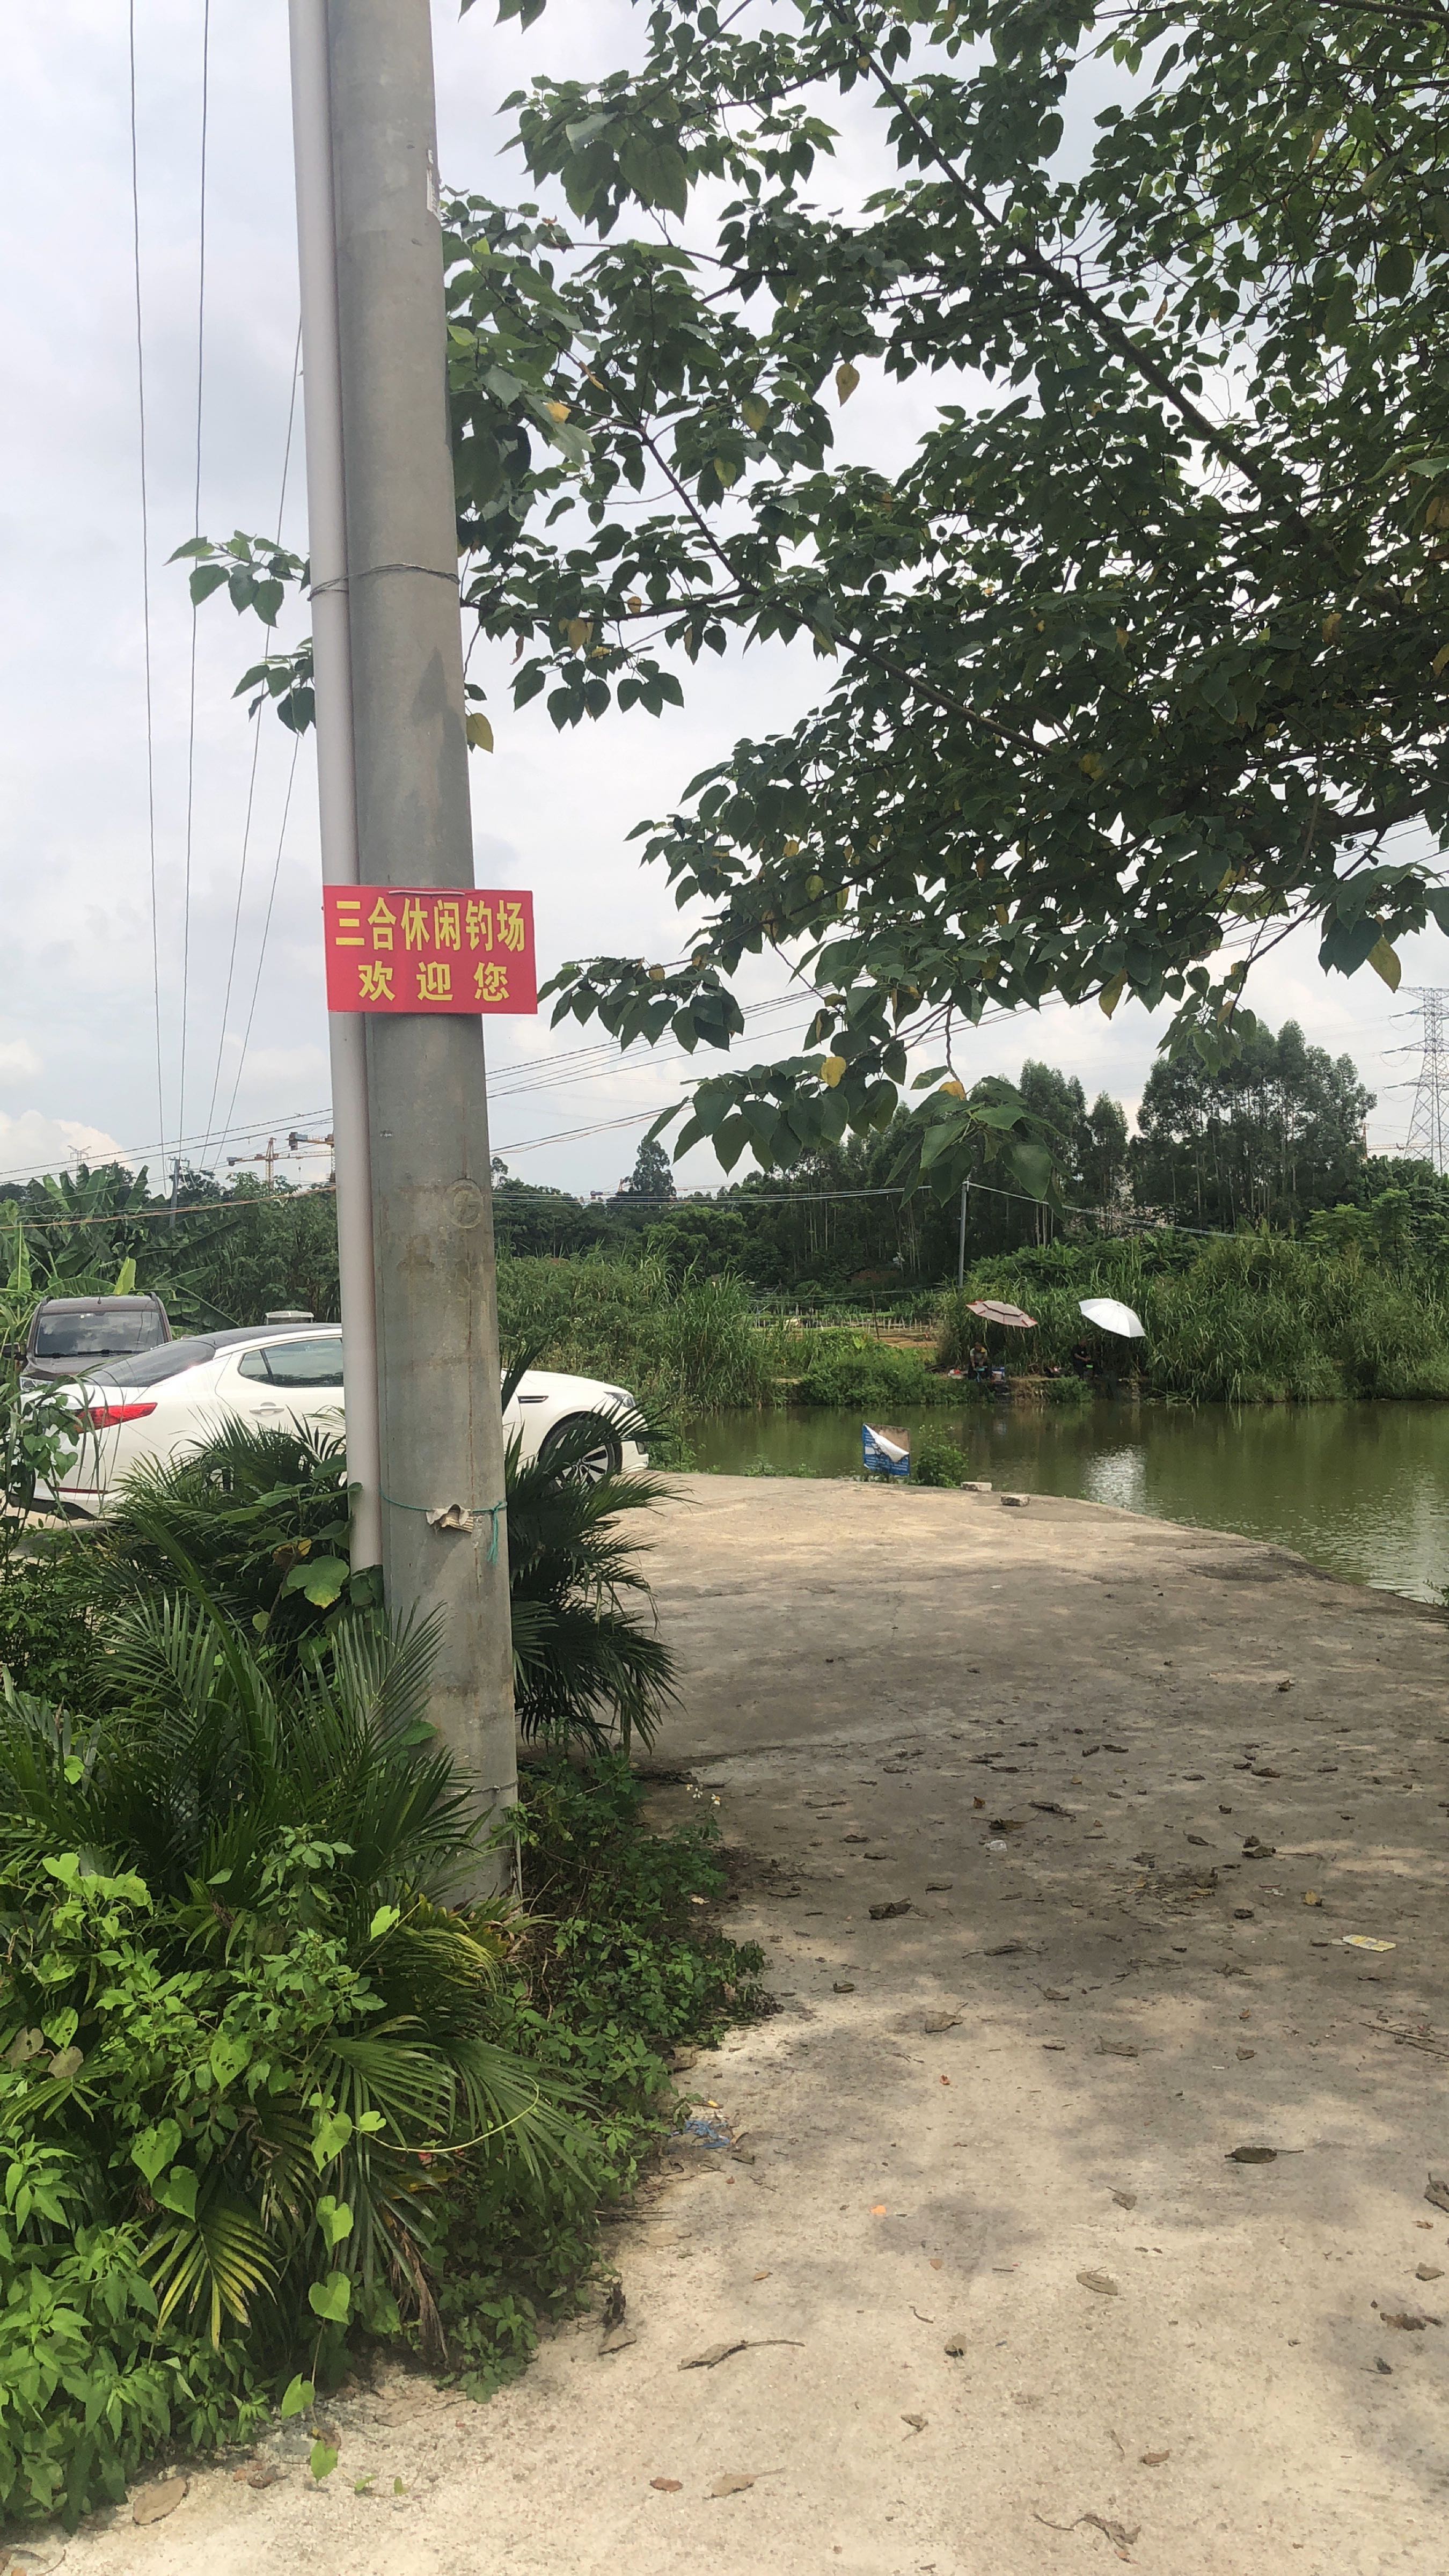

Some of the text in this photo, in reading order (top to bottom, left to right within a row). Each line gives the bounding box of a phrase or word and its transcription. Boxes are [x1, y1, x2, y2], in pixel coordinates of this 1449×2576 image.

[335, 897, 525, 952] 三合休闲钓场
[357, 961, 510, 1001] 欢迎您
